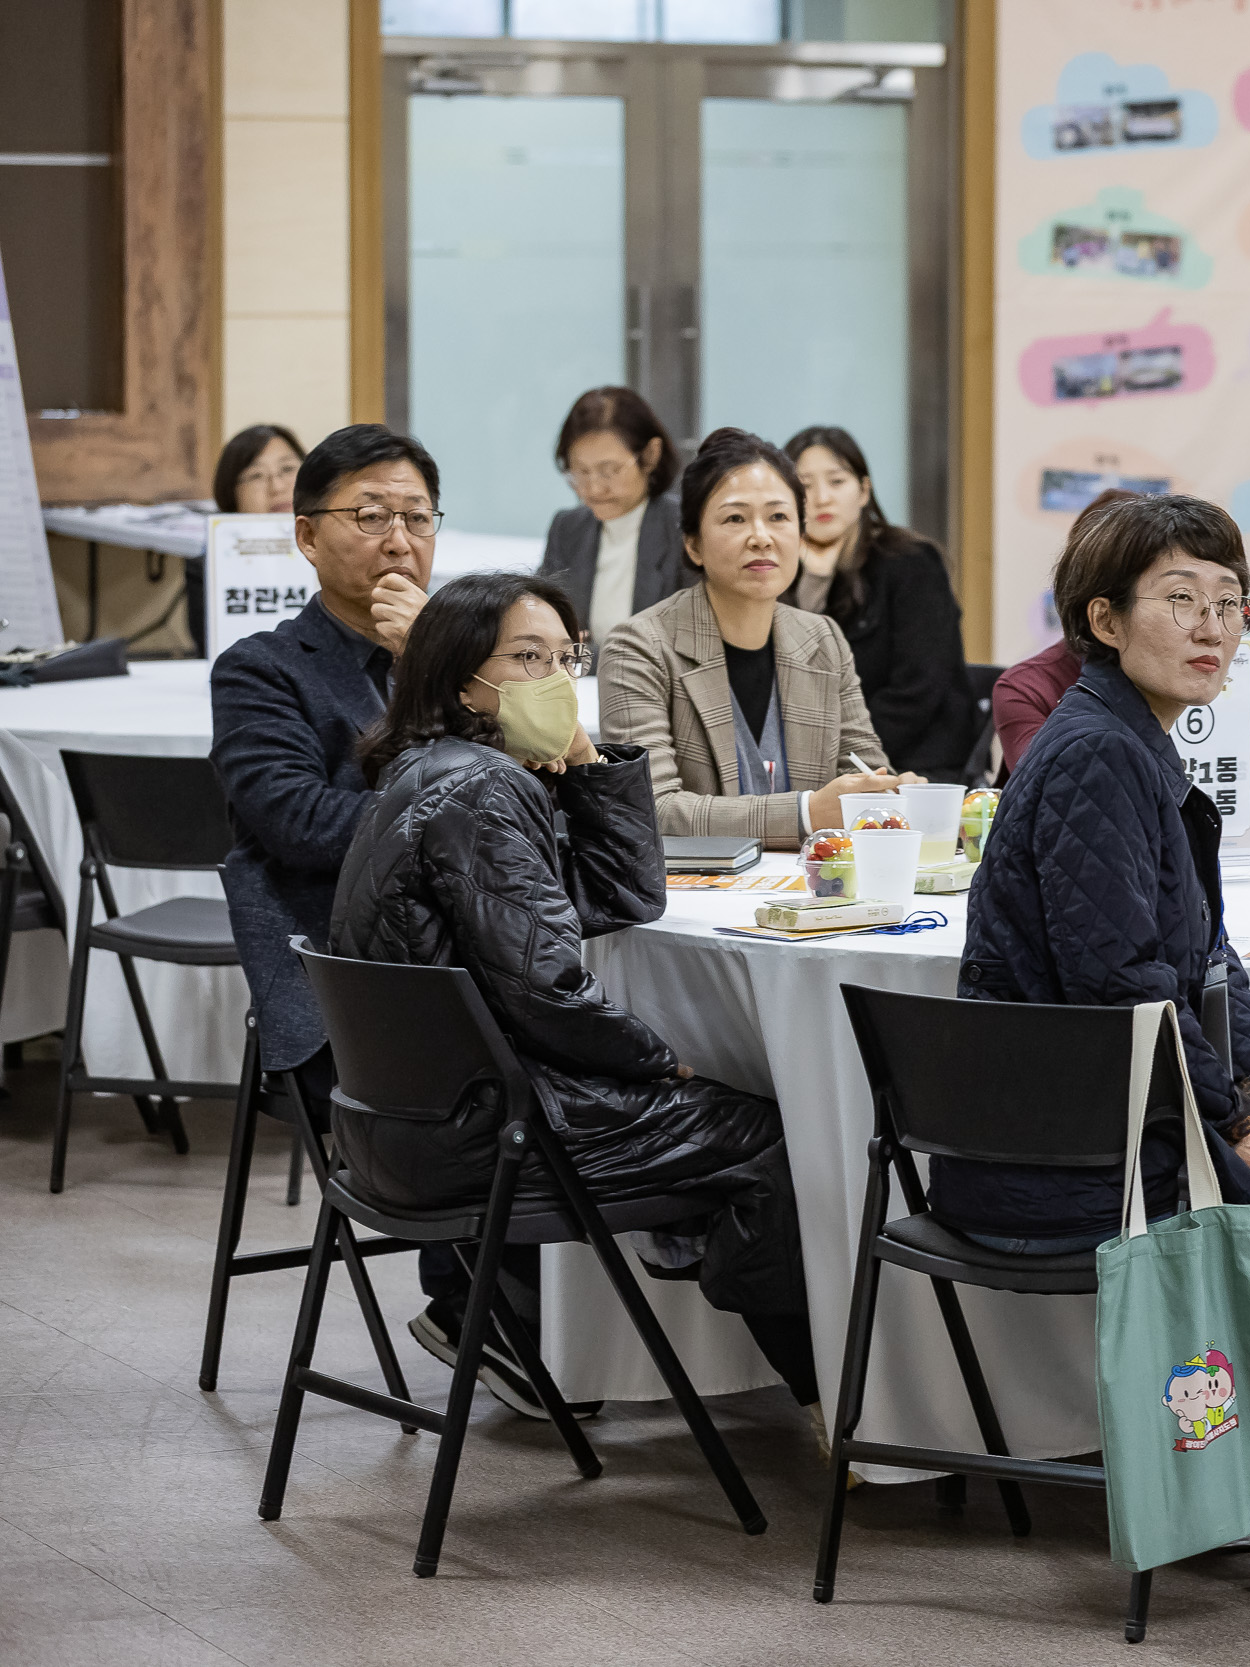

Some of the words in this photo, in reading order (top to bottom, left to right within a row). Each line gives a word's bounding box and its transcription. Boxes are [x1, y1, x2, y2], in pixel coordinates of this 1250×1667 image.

[225, 586, 307, 614] 참관석
[1186, 707, 1203, 735] 6
[1207, 789, 1237, 816] 동
